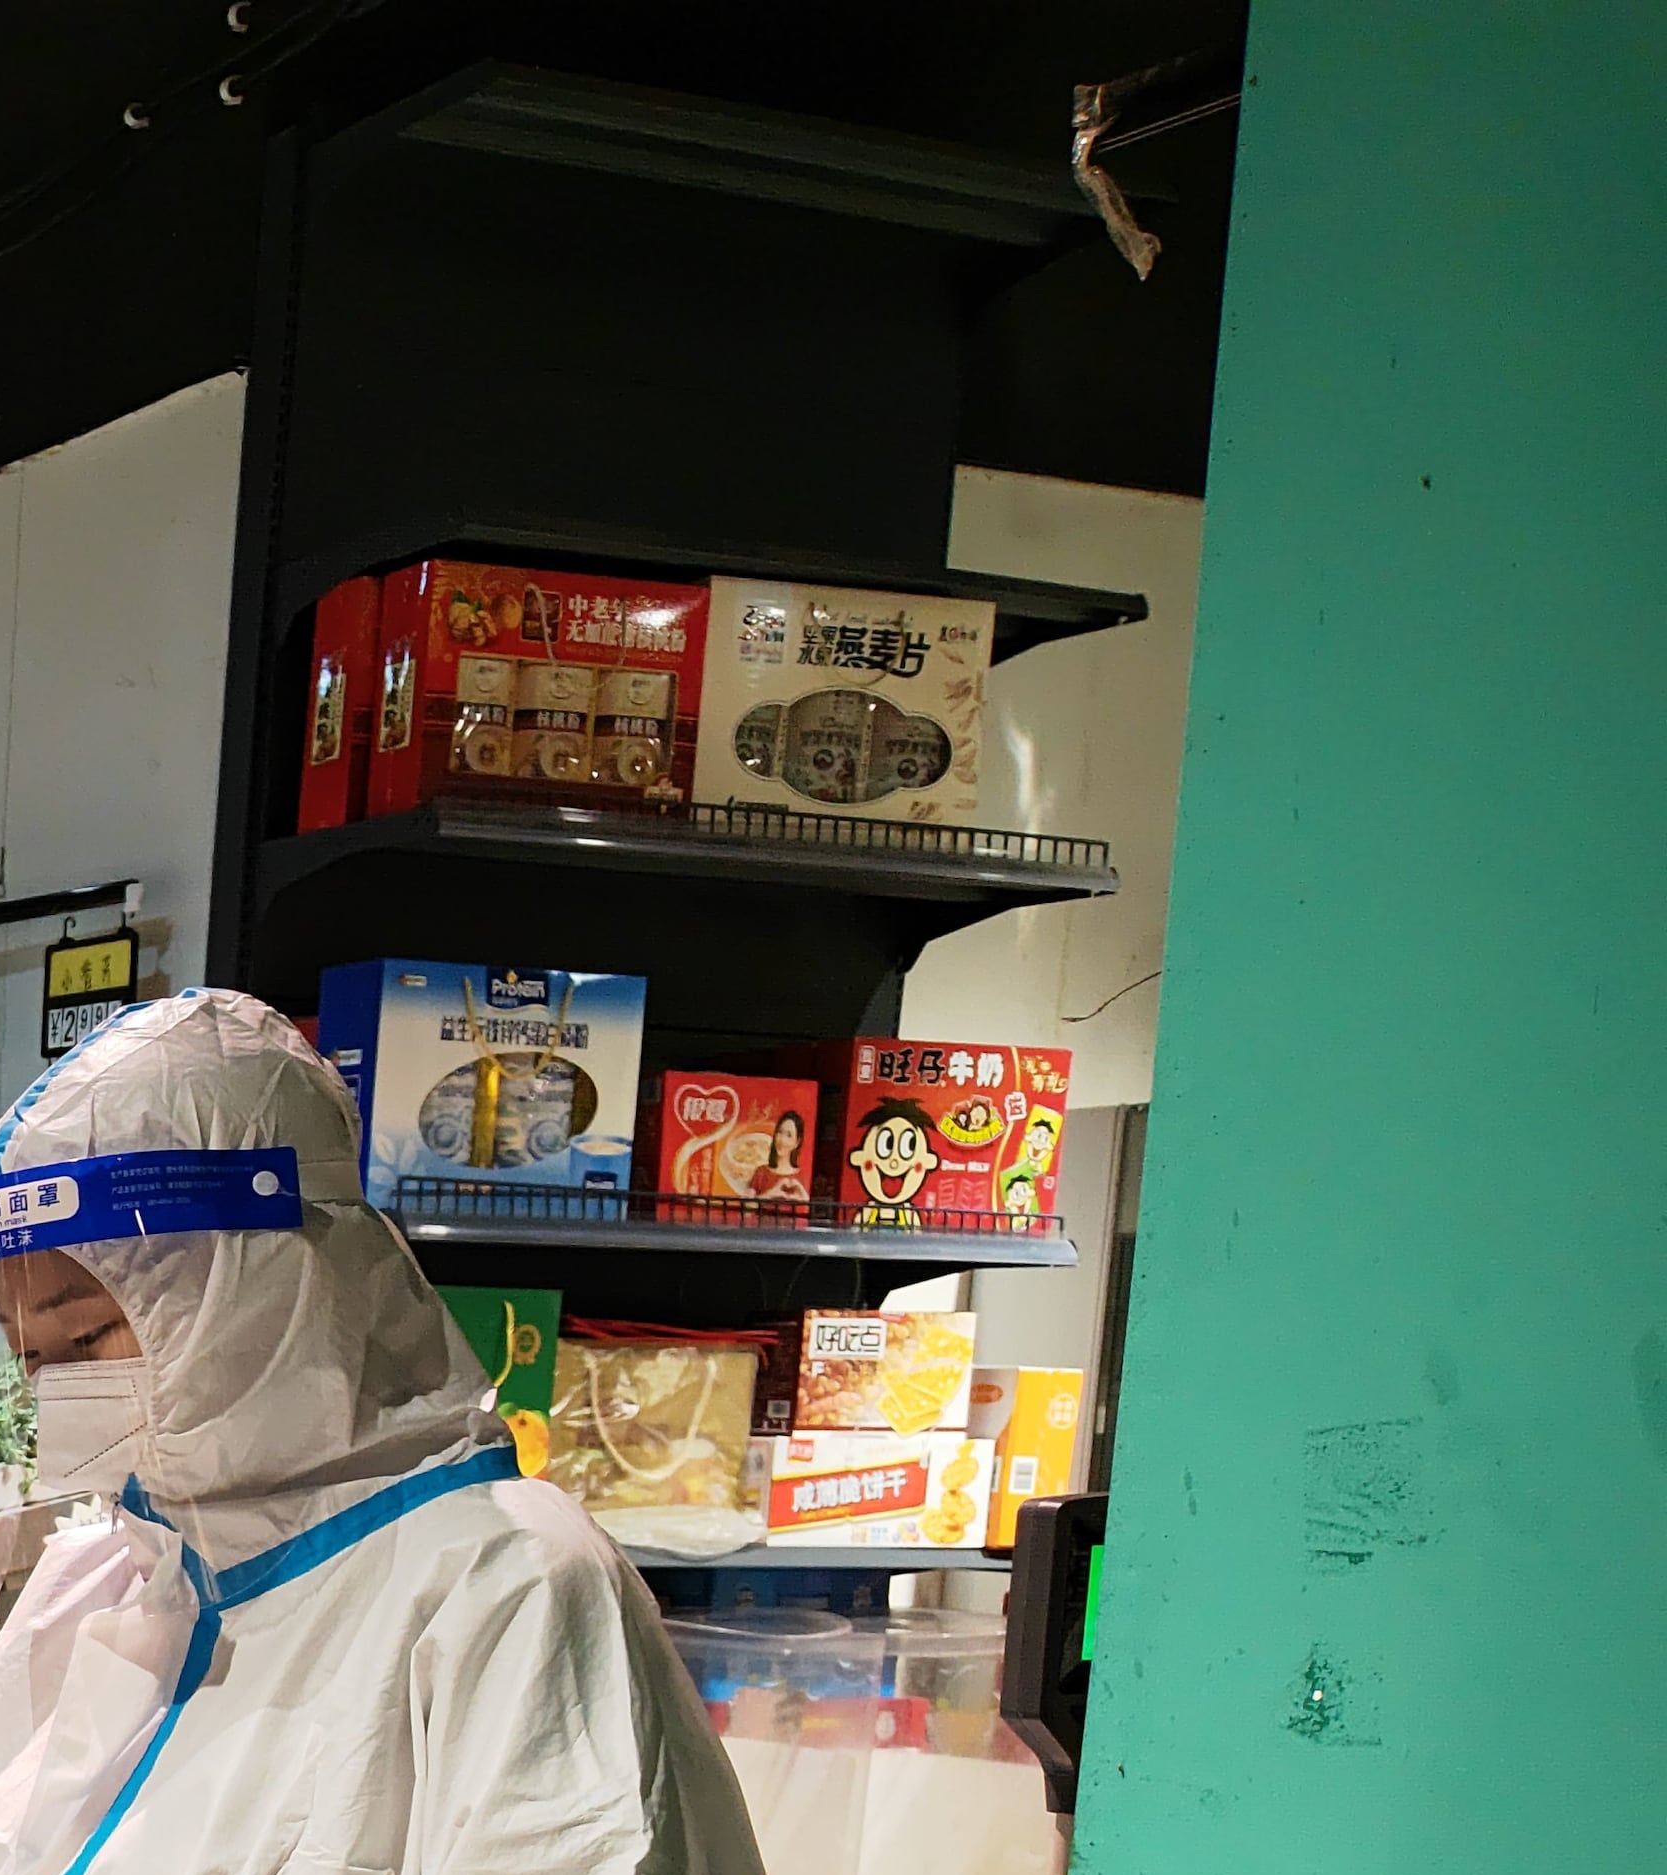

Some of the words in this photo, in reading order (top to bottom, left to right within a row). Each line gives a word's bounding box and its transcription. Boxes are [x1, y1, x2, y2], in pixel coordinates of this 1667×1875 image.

[833, 624, 931, 678] 燕麦片
[877, 1048, 1004, 1088] 旺仔牛奶
[816, 1324, 882, 1352] 好吃点
